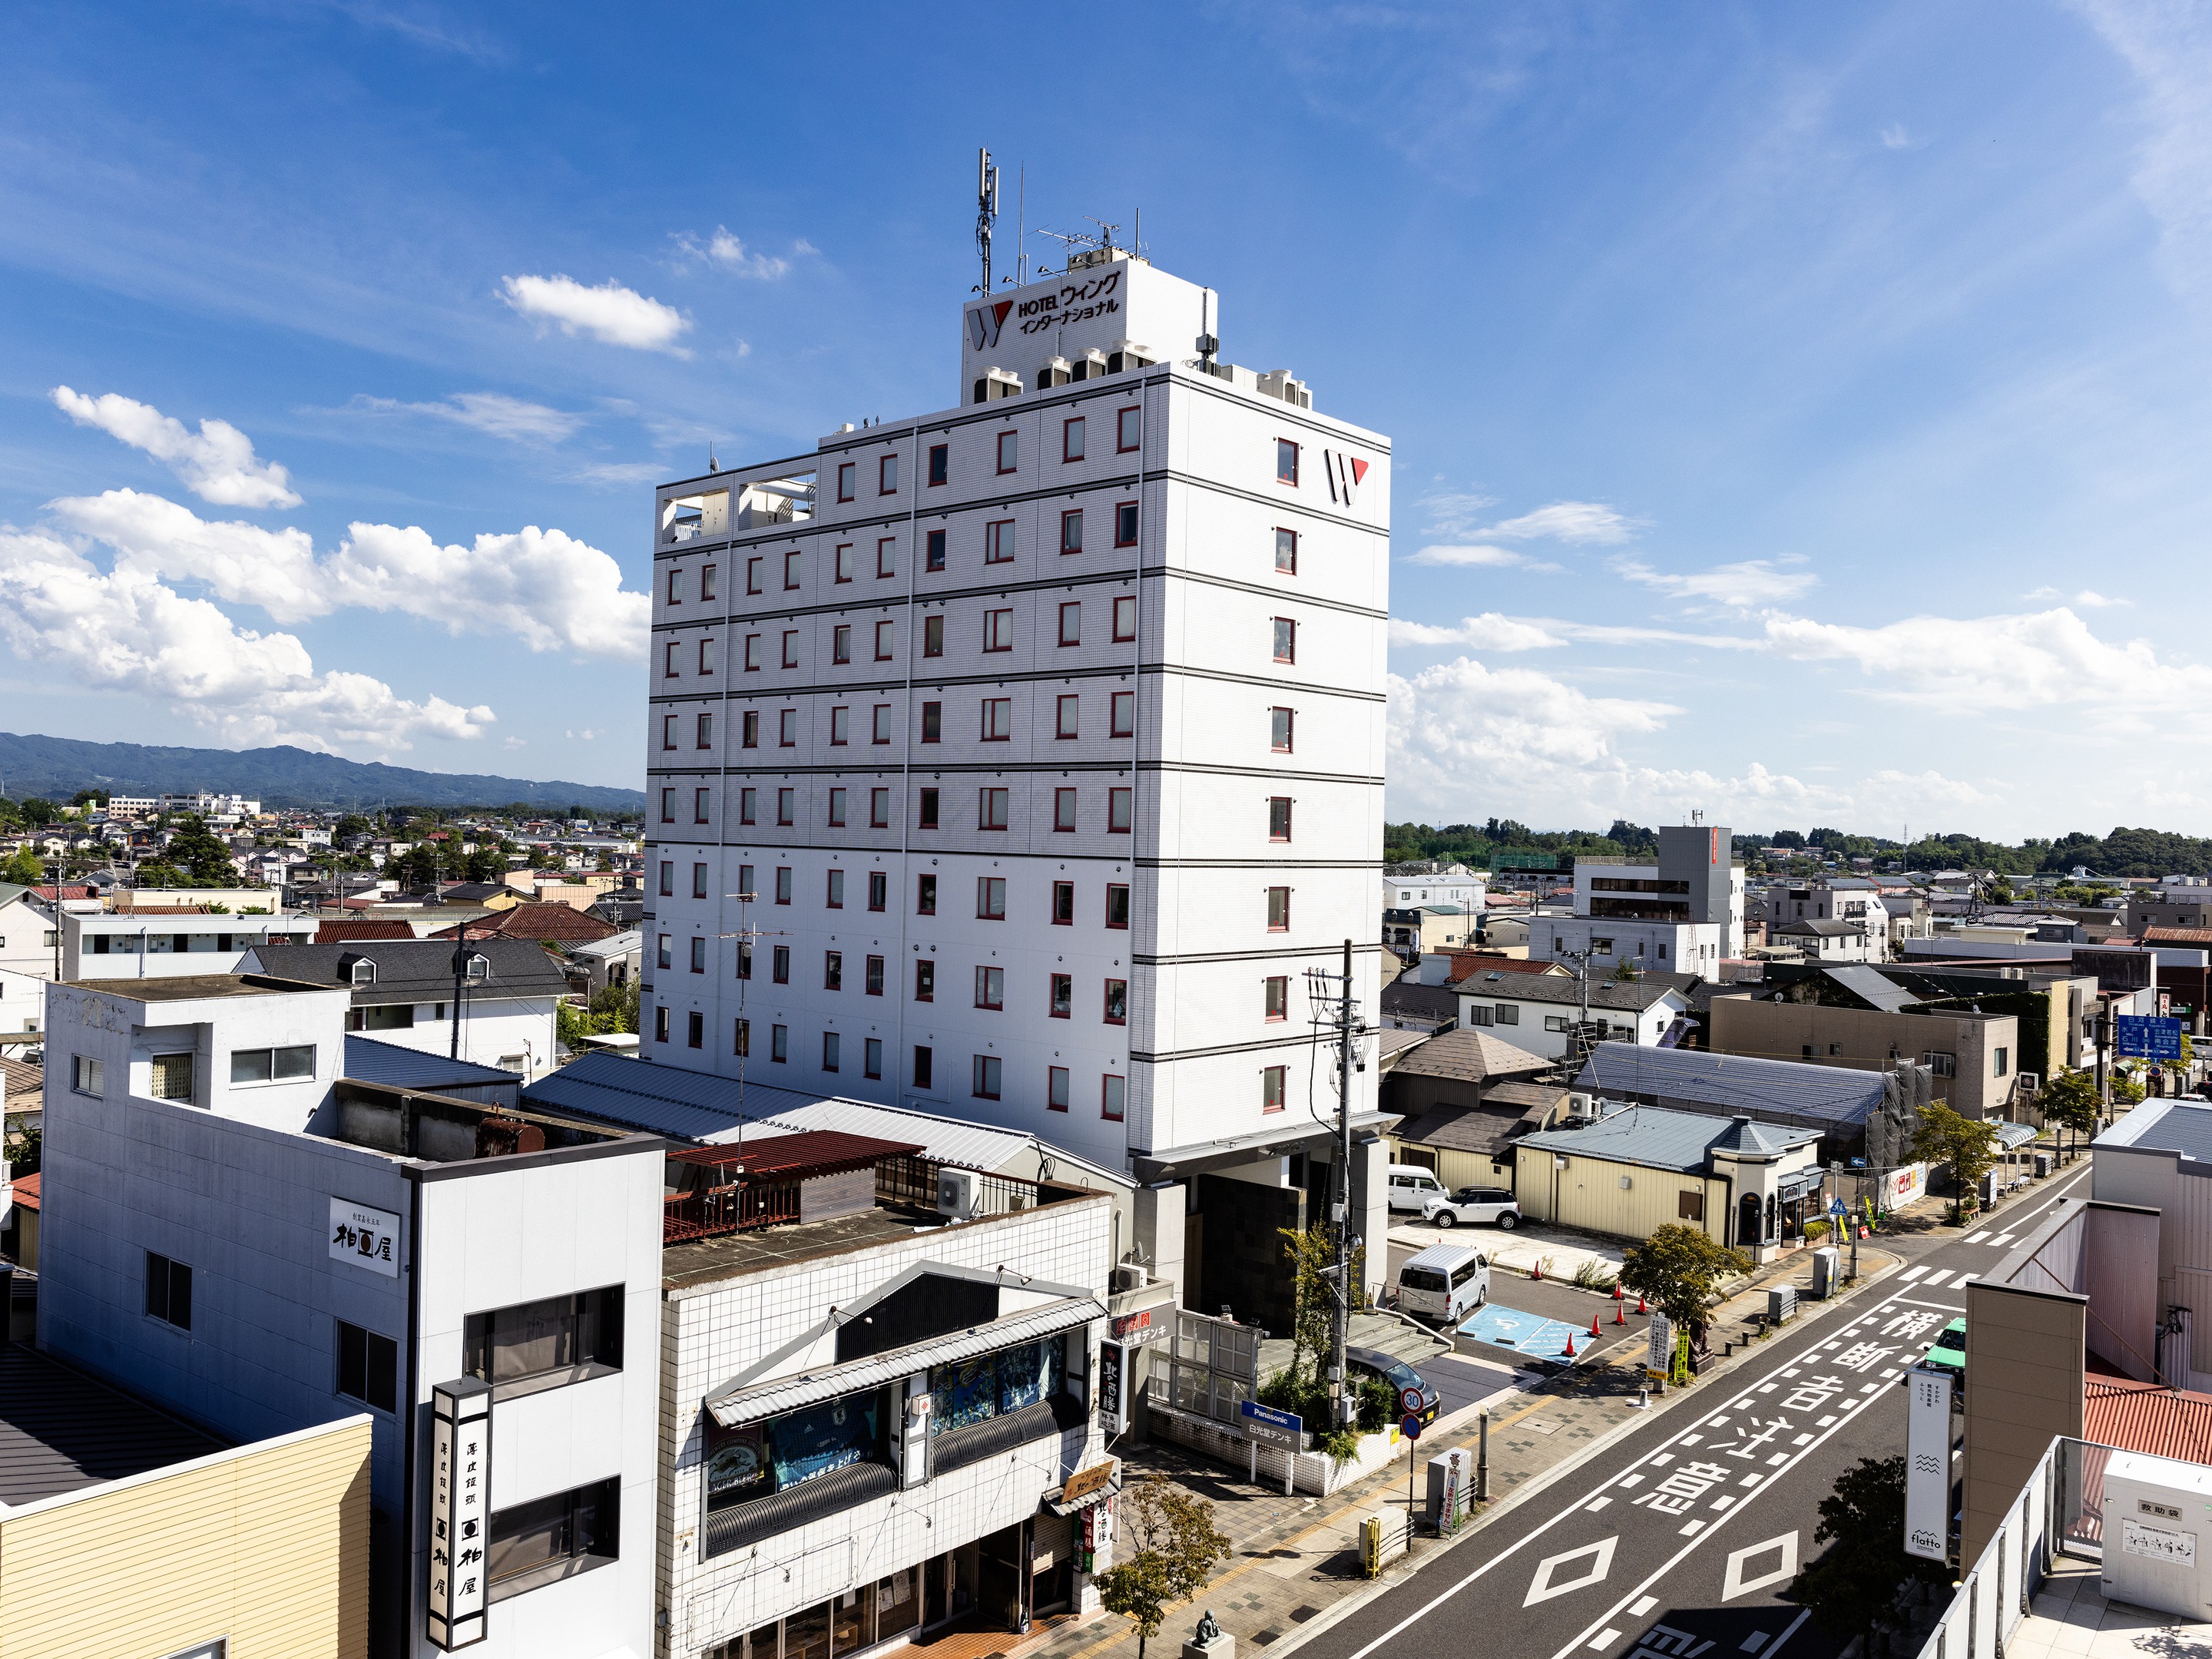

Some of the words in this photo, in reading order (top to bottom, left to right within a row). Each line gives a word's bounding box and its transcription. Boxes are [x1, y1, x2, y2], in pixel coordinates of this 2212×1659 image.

[1018, 295, 1058, 318] HOTEL
[1061, 270, 1121, 306] ウィング
[1020, 299, 1119, 334] インターナショナル
[353, 1213, 381, 1227] 創業嘉永五年
[1406, 1393, 1419, 1408] 30
[1253, 1408, 1288, 1425] Panasonic
[1249, 1423, 1292, 1444] 白光堂デンキ
[733, 1472, 753, 1486] BEER
[1444, 1487, 1455, 1525] 左折できません
[2141, 1503, 2179, 1518] 救助袋
[1911, 1534, 1941, 1549] flatto
[432, 1547, 449, 1598] 柏屋
[456, 1547, 483, 1597] 柏屋
